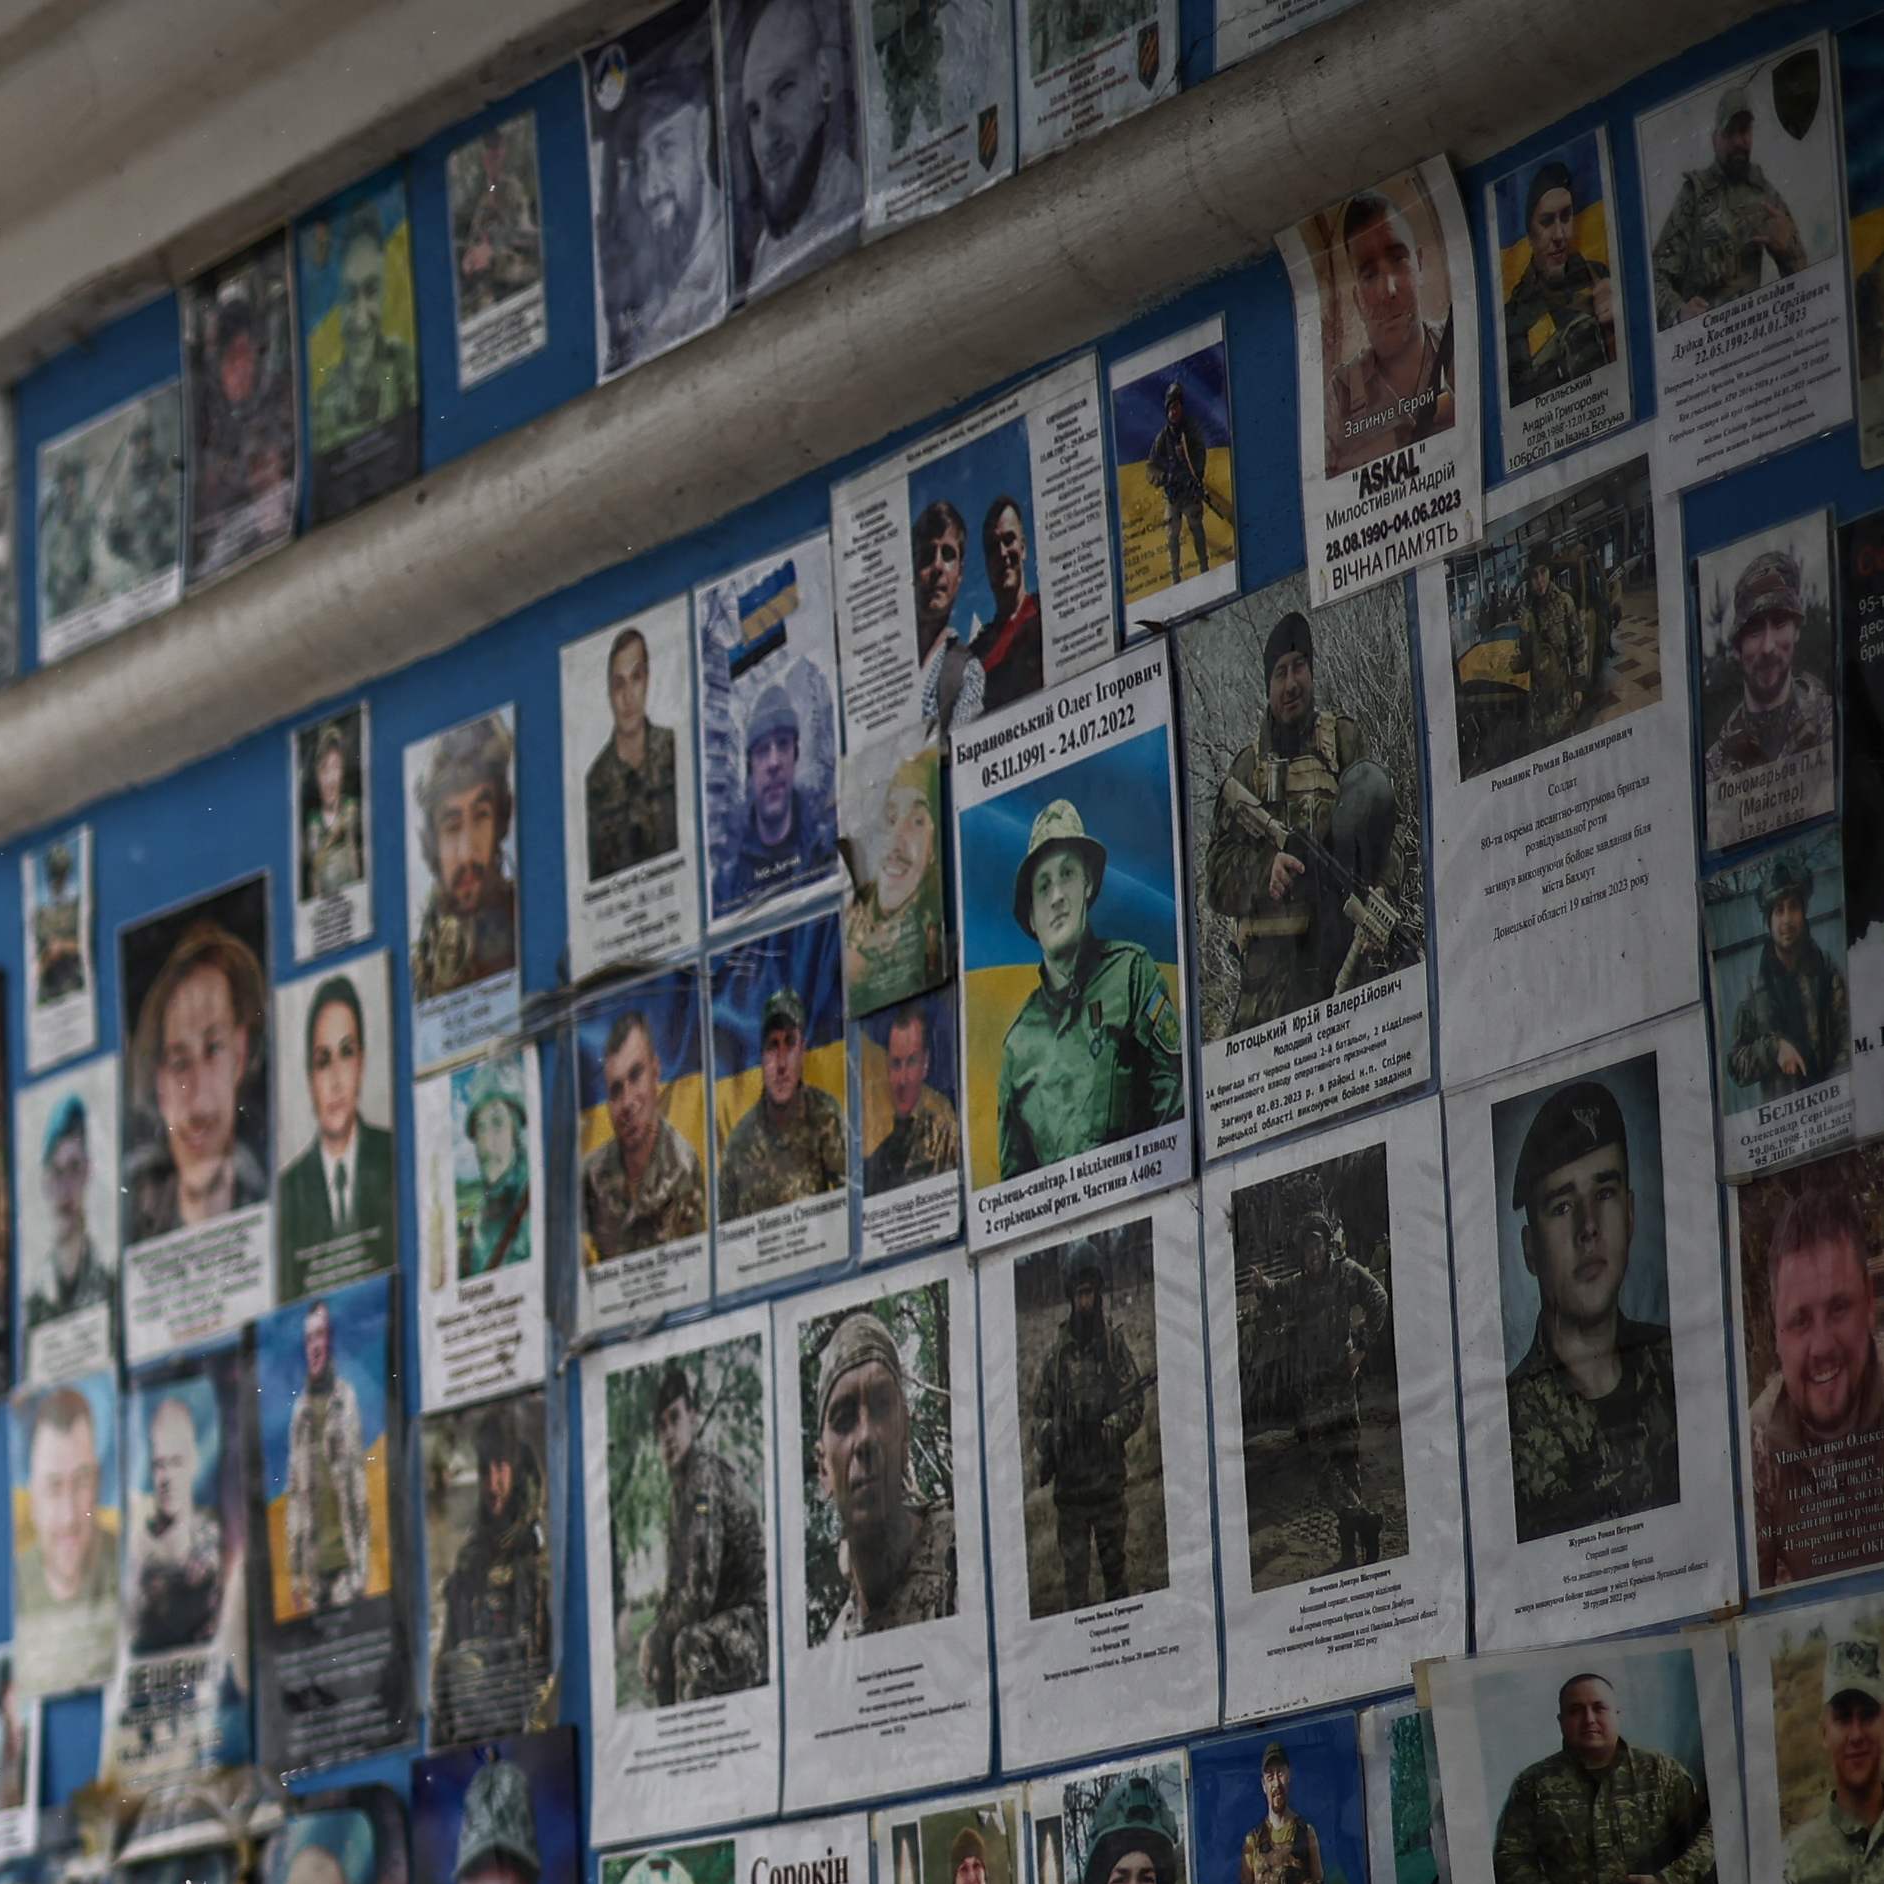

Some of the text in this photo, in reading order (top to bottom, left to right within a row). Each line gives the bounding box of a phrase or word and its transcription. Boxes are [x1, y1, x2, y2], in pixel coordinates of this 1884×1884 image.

[1702, 281, 1795, 328] Старший солдат
[1707, 311, 1768, 342] Костянтин
[1772, 282, 1830, 313] Сергійович
[1344, 389, 1434, 438] Загинув Герой
[1523, 387, 1609, 433] Андрій Григорович
[1535, 375, 1593, 408] Рогальський
[1326, 461, 1455, 530] Милостивий Андрій
[1352, 444, 1426, 499] "ASKAL"
[1326, 489, 1461, 562] 28.08.1990-04.06.2023
[1333, 522, 1457, 589] ВІЧНА ПАМ'ЯТЬ
[956, 661, 1162, 765] Барановський Олег Ігорович
[982, 704, 1135, 788] 05.11.1991 24.07.2022
[1491, 727, 1633, 793] Романюк Роман Володимирович
[1547, 777, 1577, 797] Солдат
[1718, 763, 1797, 800] Пономарьов
[1739, 782, 1803, 821] (Майстер)
[1565, 867, 1595, 888] Бахмут
[1225, 979, 1402, 1058] Лотоцький Юрій Валерійович
[1256, 1050, 1411, 1114] 02.03.2023 Спірне
[1758, 1085, 1841, 1125] Бєляков
[978, 1133, 1178, 1213] Стрілець-санітар. відділення взводу
[994, 1160, 1162, 1232] стрілецької Частина А4062
